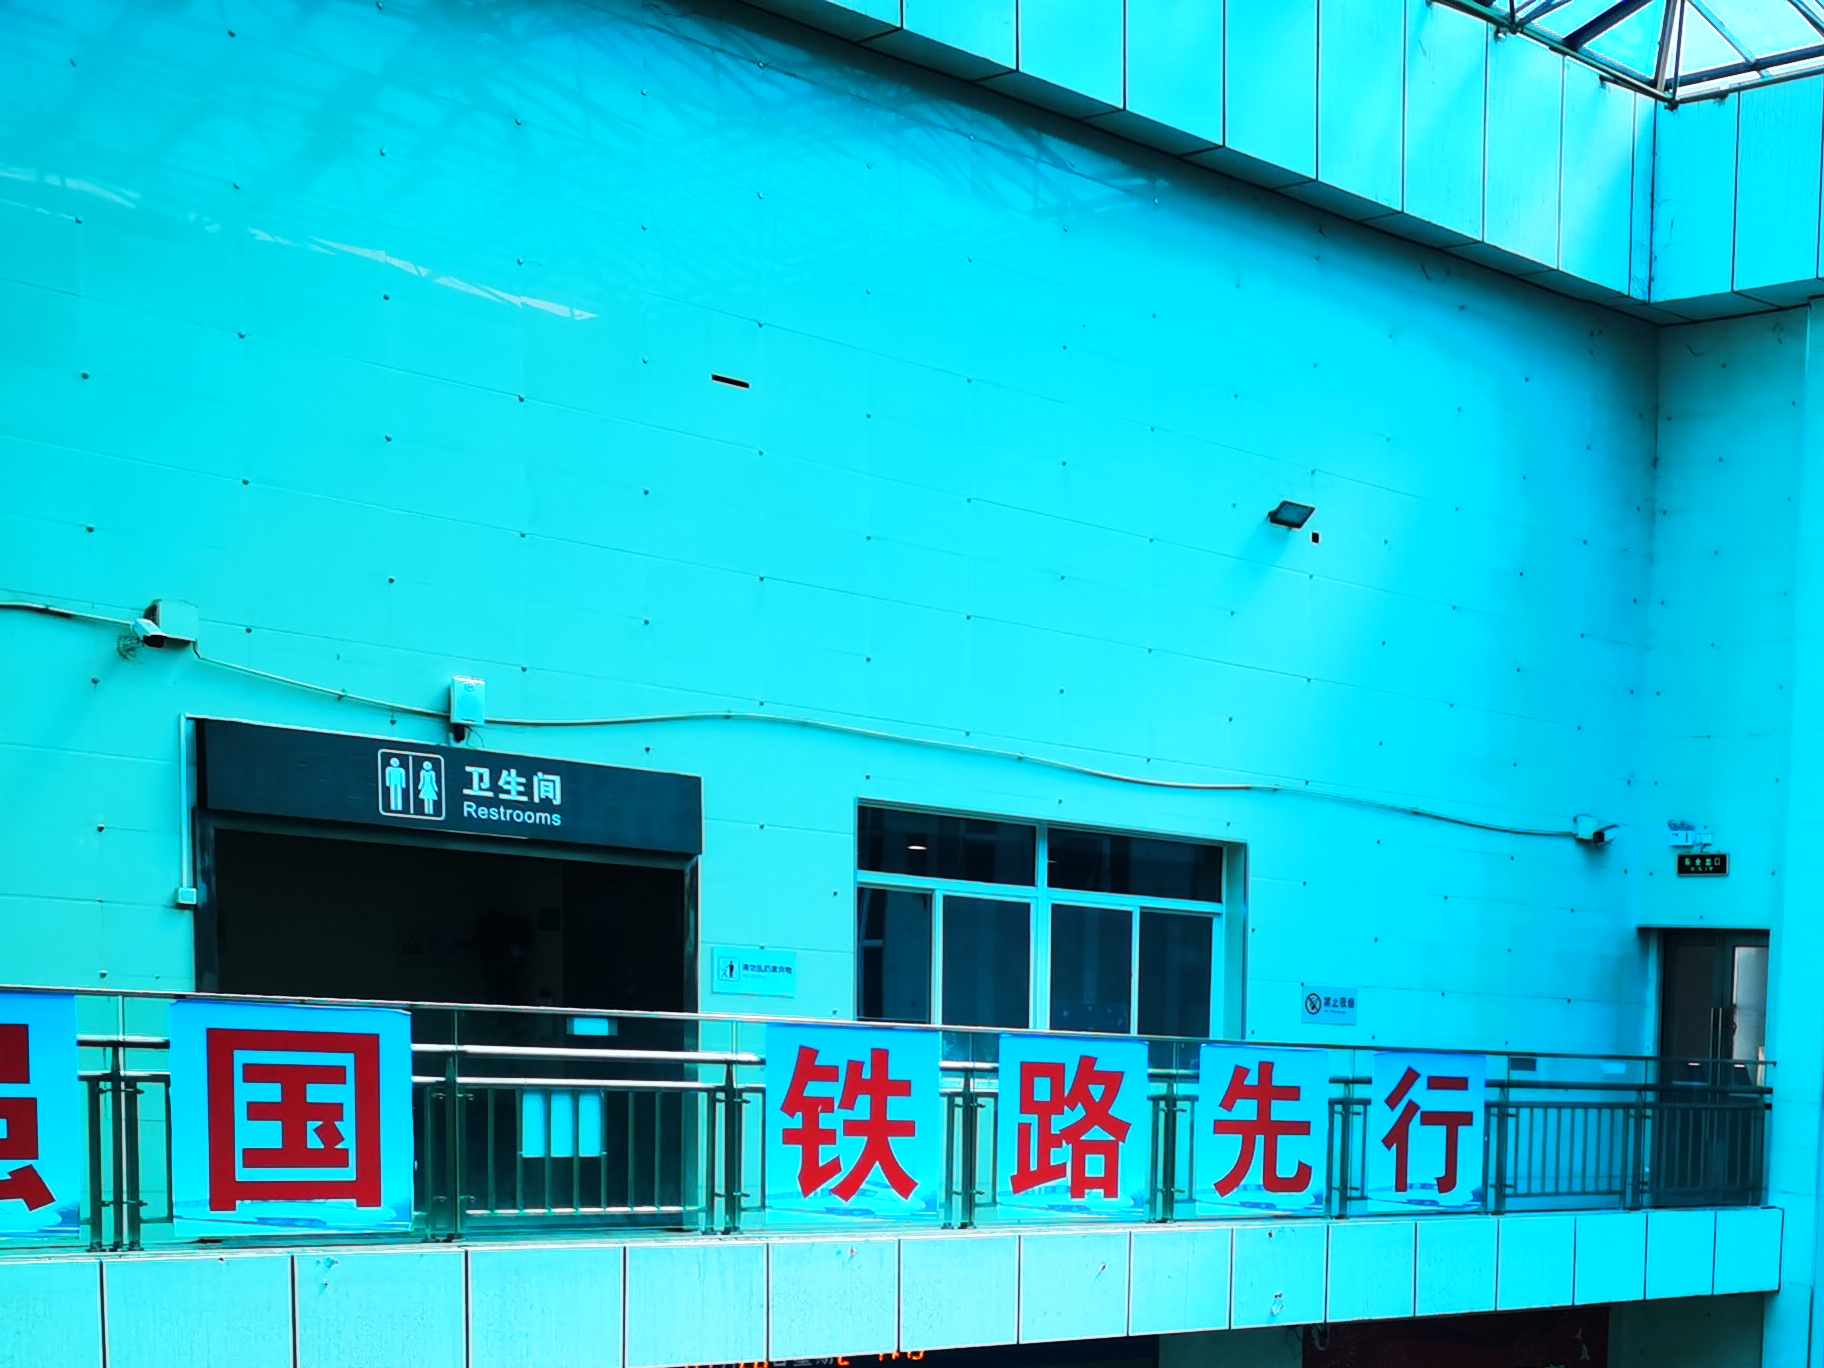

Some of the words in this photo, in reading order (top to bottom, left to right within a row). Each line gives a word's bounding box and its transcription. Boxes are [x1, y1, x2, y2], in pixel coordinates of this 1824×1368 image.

[463, 764, 563, 807] 卫生间
[462, 801, 563, 828] Restrooms
[781, 1045, 1476, 1203] 铁路先行
